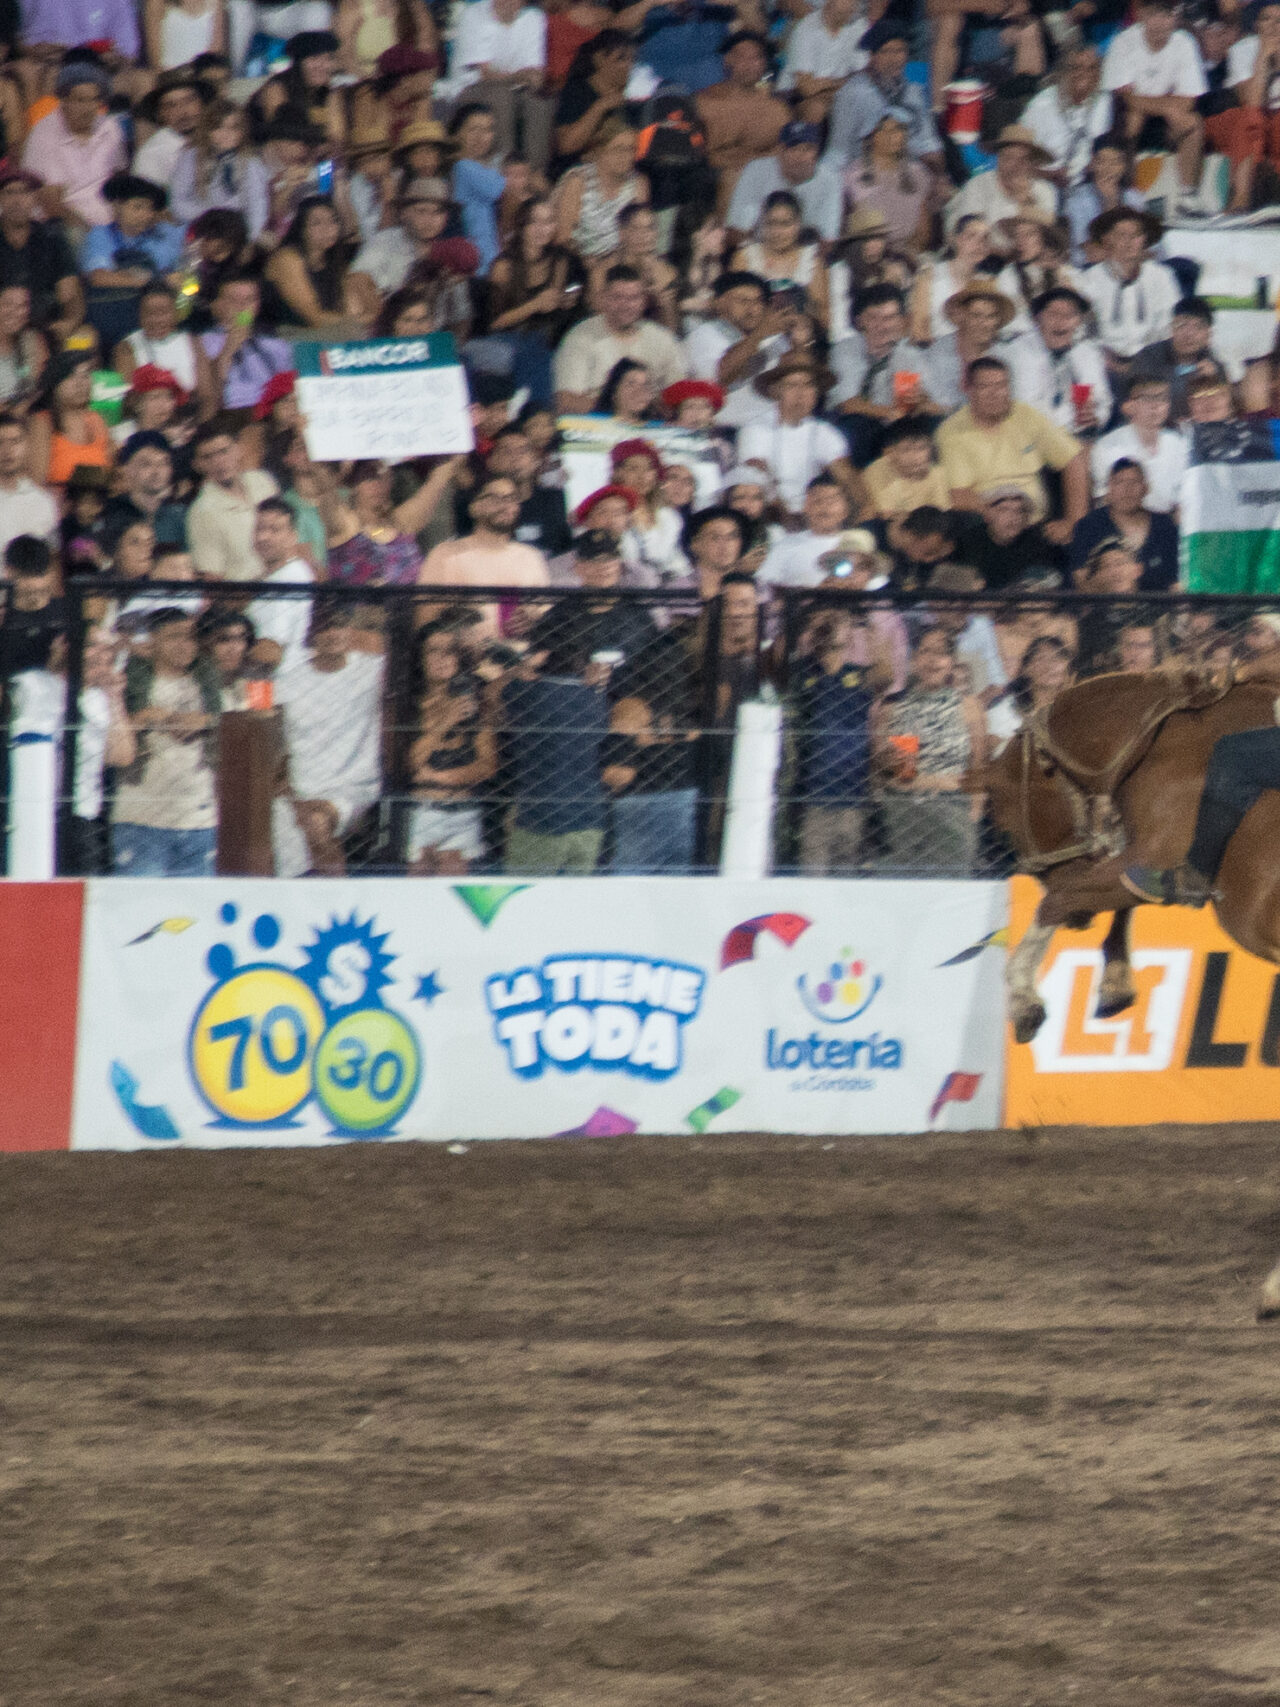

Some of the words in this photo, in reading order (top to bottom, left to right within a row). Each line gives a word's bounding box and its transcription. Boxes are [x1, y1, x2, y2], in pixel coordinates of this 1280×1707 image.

[327, 341, 432, 370] BANCOR
[488, 972, 544, 1011] LA
[544, 958, 702, 1015] TIENE
[208, 1004, 308, 1092] 70
[499, 1003, 681, 1071] TODA
[766, 1027, 903, 1069] lotería
[328, 1036, 405, 1103] 30
